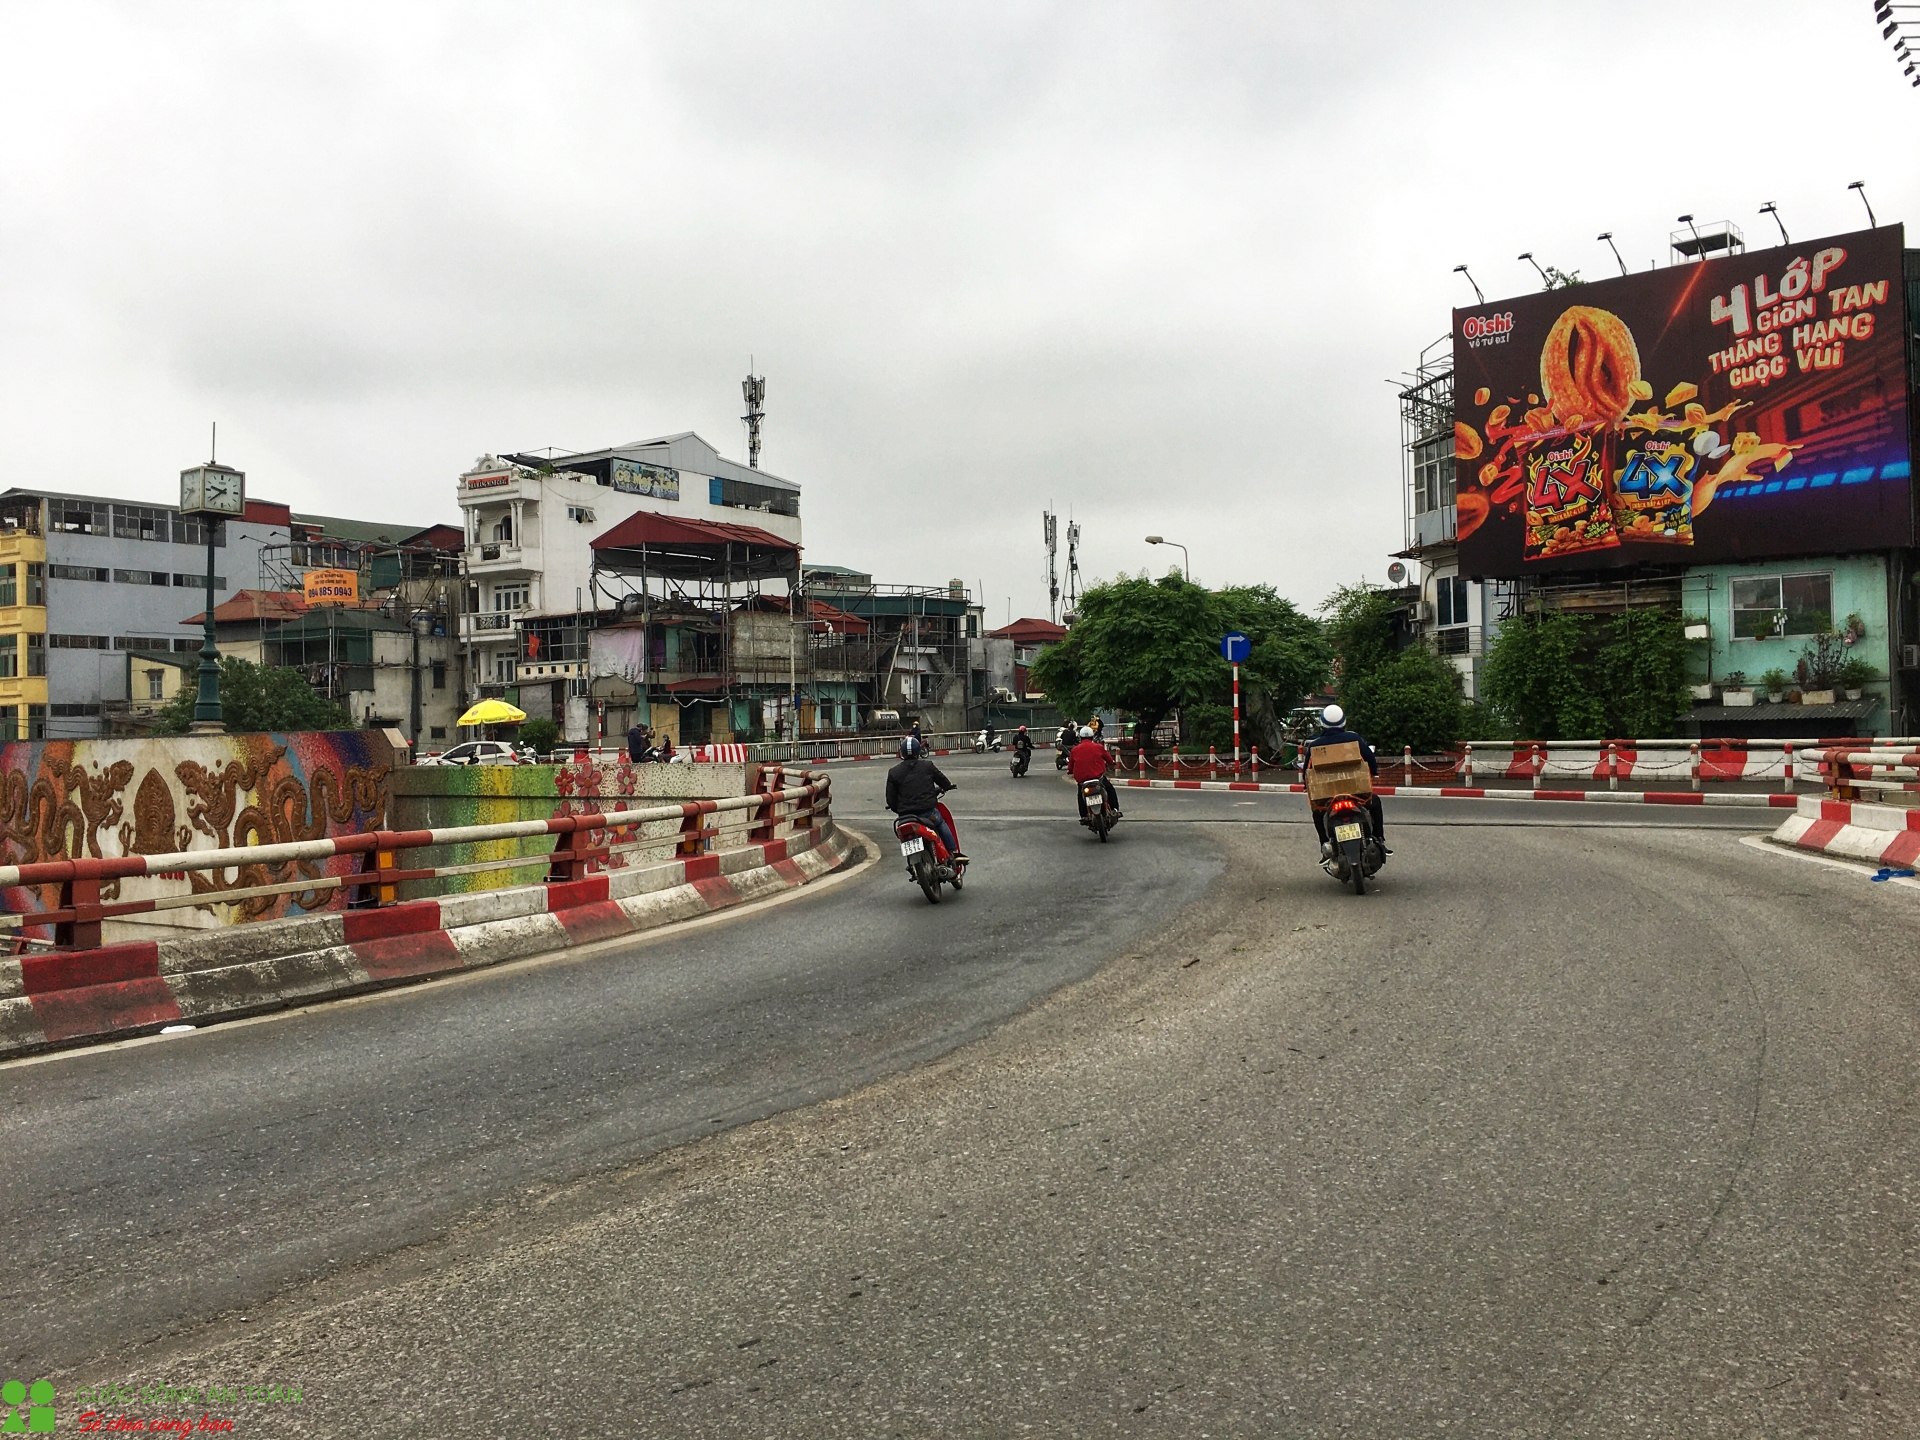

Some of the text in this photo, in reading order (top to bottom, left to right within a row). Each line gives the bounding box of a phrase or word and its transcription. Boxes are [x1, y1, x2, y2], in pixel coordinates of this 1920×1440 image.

[1710, 247, 1848, 337] 4 LỚP
[1828, 279, 1889, 315] TAN
[1463, 311, 1513, 340] Oishi
[1729, 355, 1788, 389] CUỘC
[1547, 448, 1574, 462] Oishi
[1645, 440, 1670, 451] Oishi
[1532, 459, 1602, 513] 4X
[1619, 452, 1691, 500] 4X
[334, 586, 352, 597] 0943
